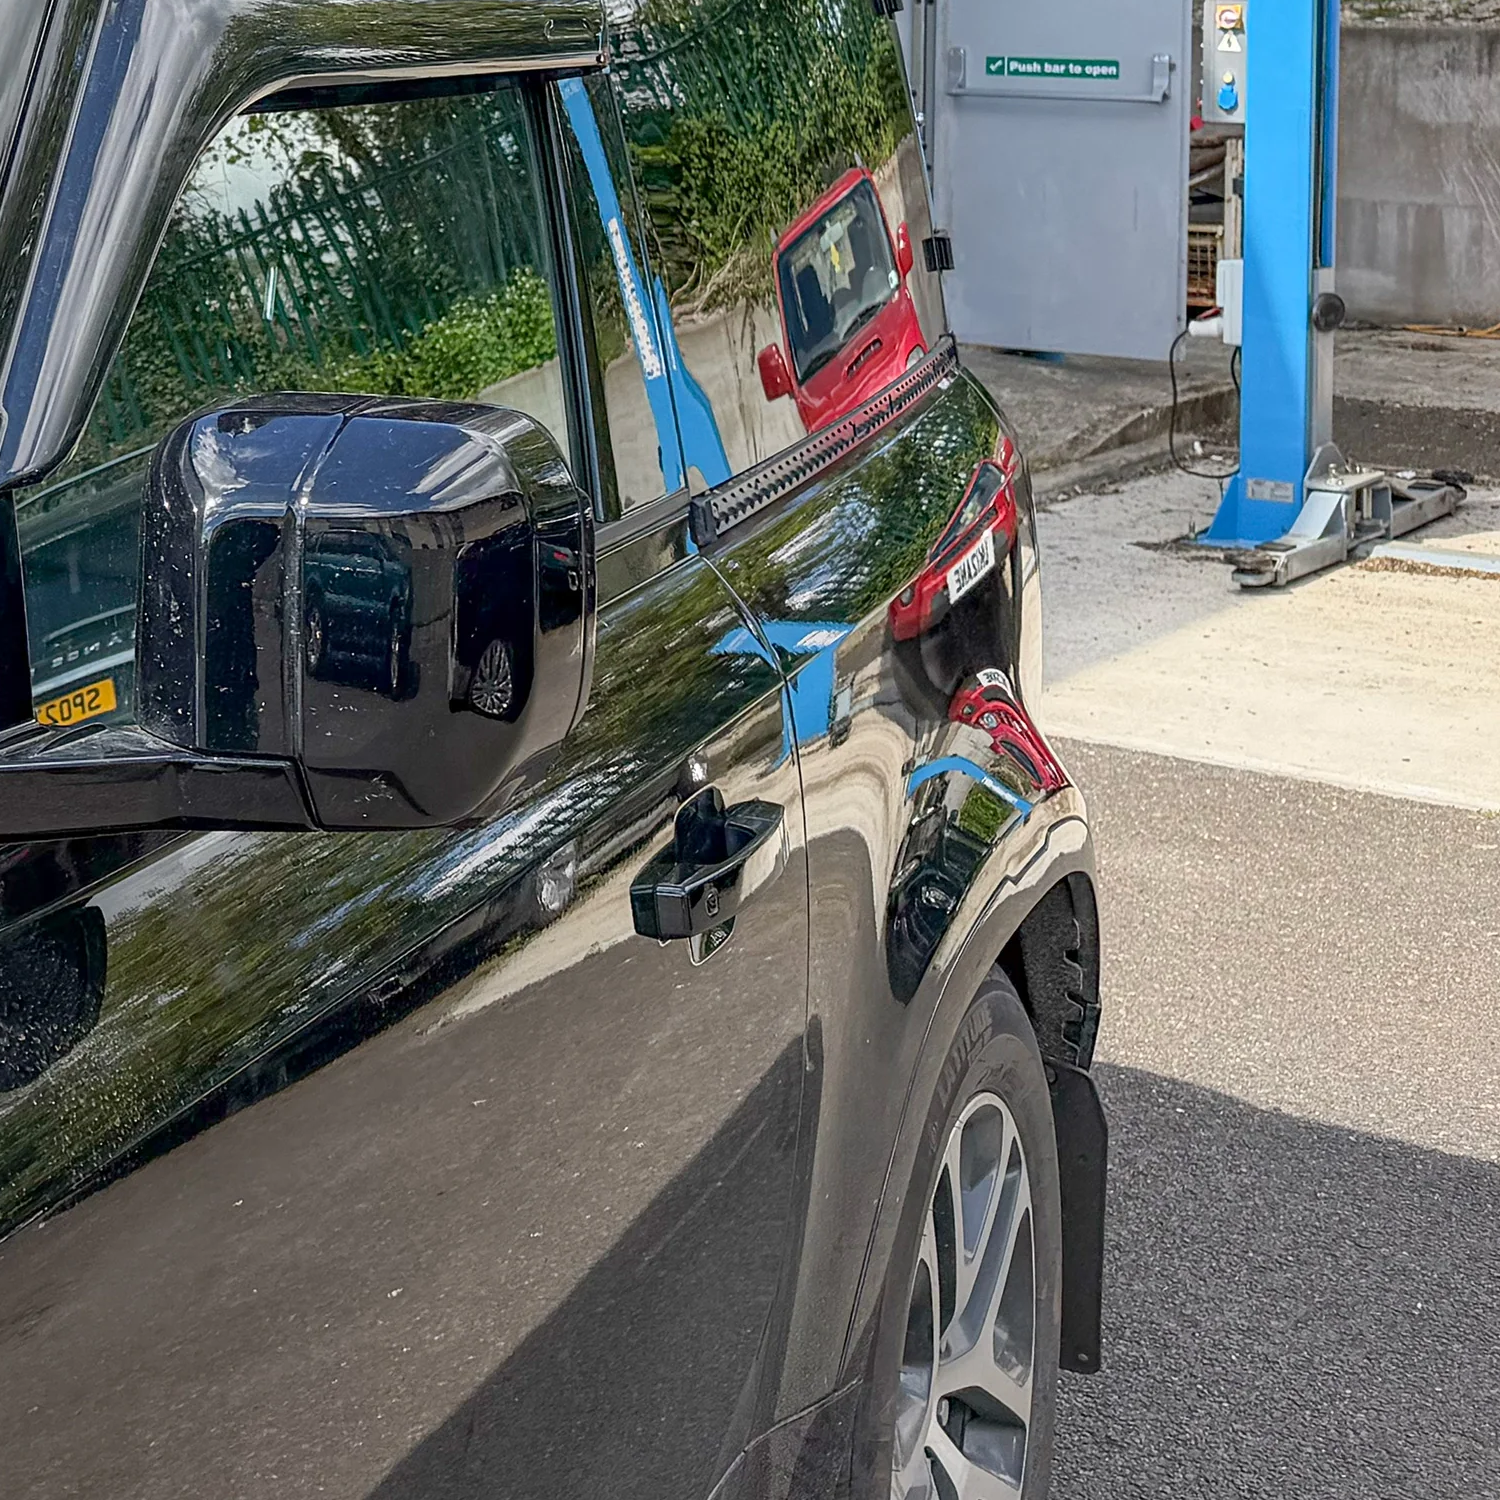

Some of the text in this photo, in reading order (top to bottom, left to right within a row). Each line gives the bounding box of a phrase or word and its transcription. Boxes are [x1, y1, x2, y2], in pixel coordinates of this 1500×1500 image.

[1009, 60, 1117, 77] Push bar to open
